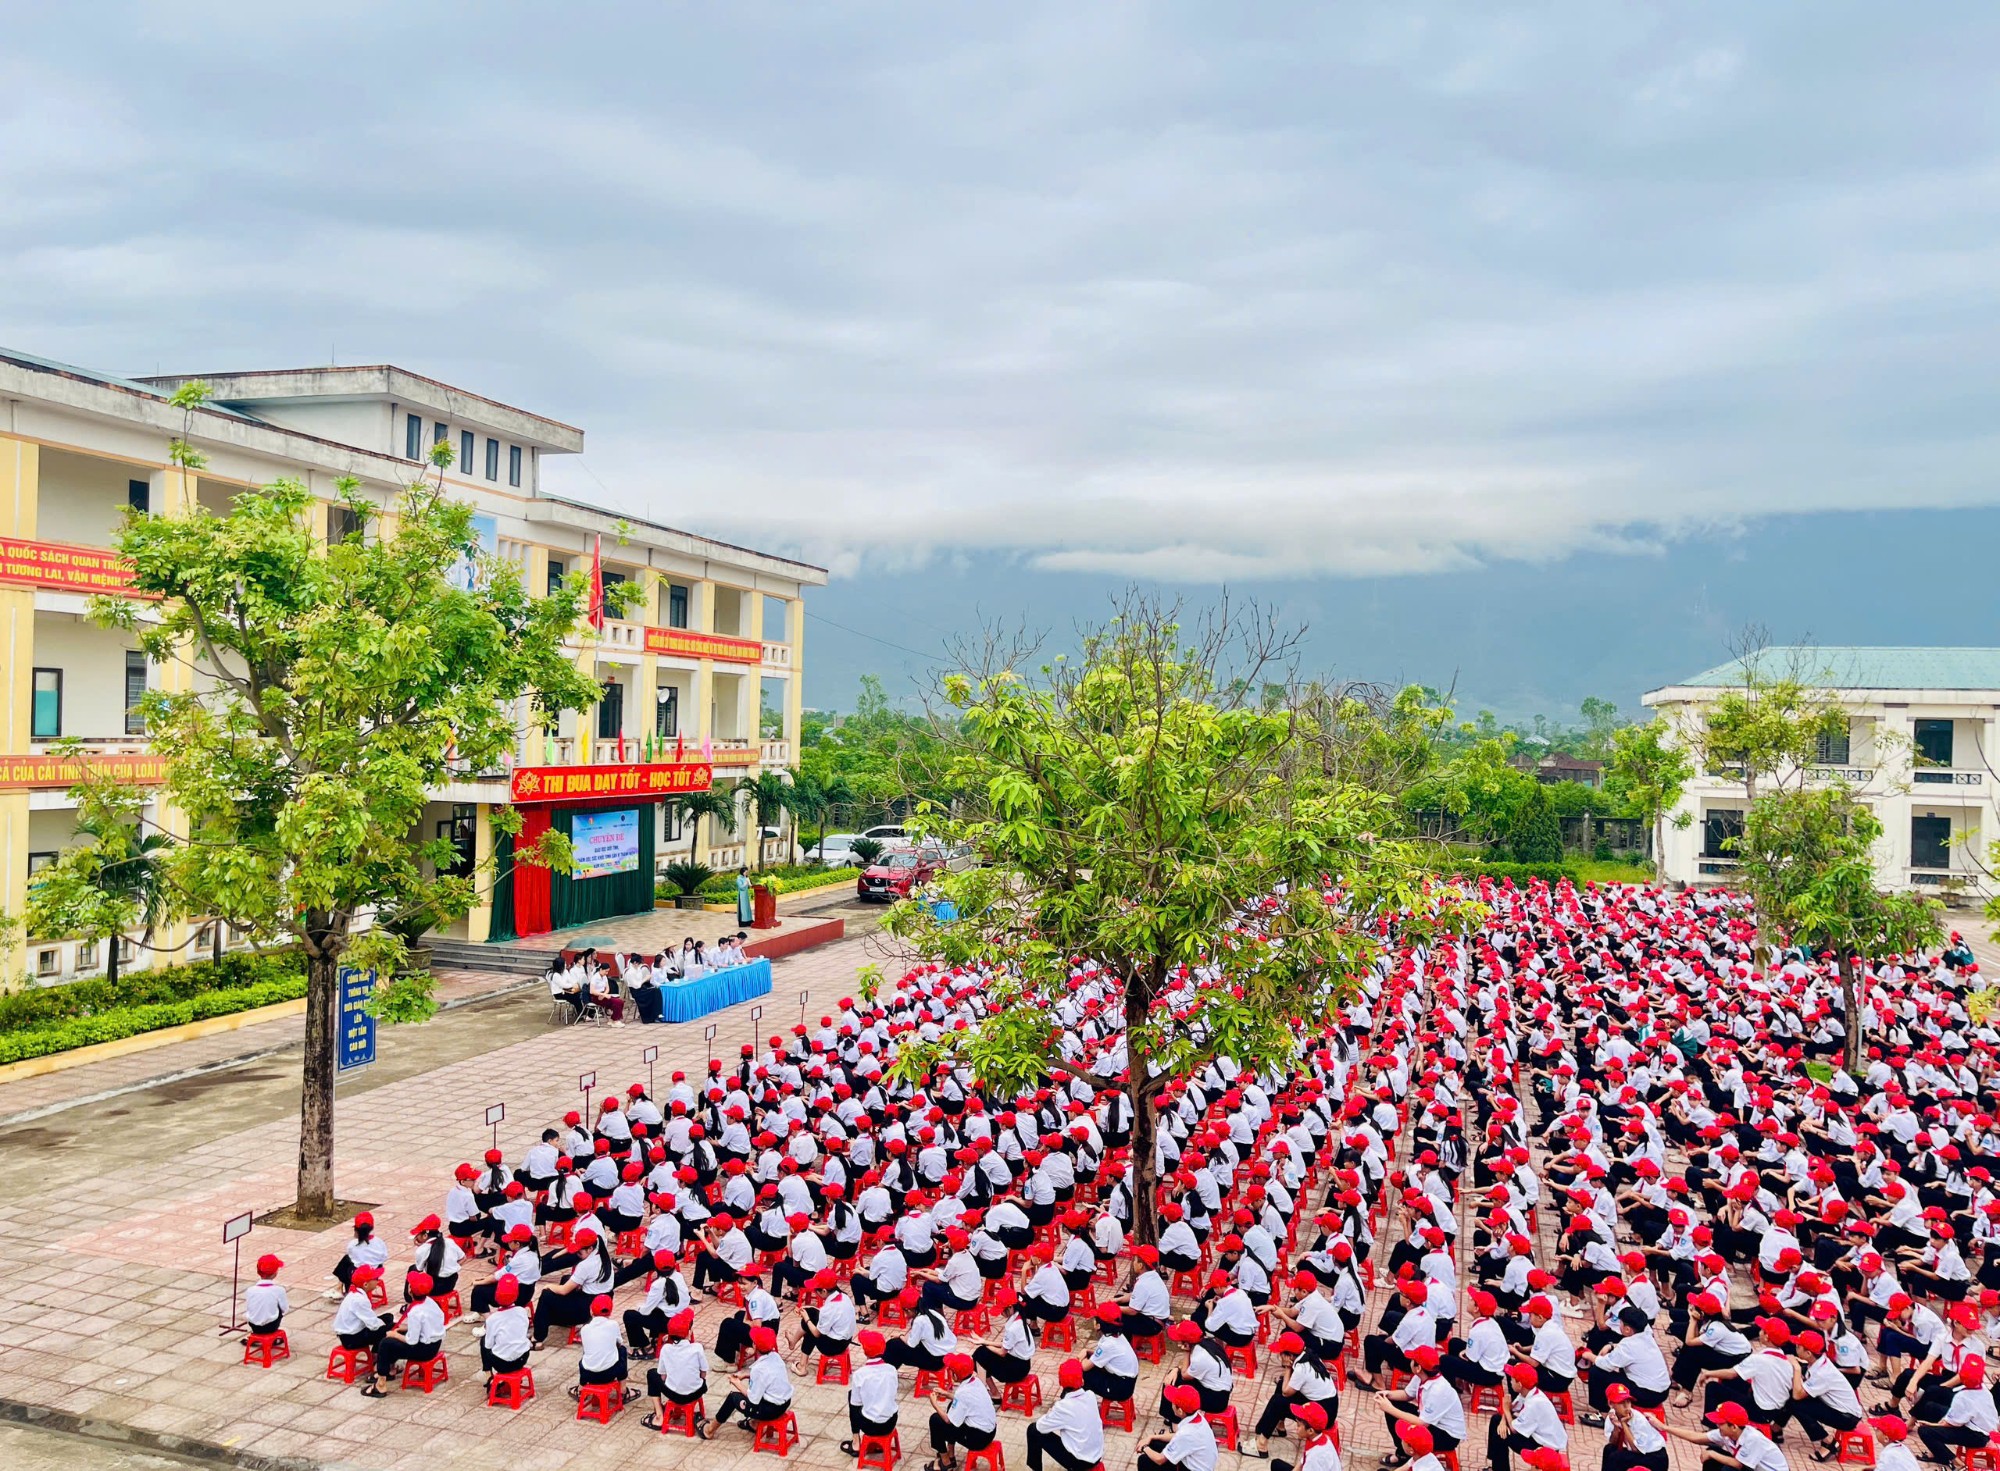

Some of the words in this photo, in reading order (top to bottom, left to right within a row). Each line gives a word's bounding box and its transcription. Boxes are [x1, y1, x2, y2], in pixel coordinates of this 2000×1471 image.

[8, 545, 37, 560] QUỐC
[41, 550, 69, 564] SÁCH
[72, 555, 100, 569] QUAN
[6, 563, 42, 578] TƯƠNG
[45, 568, 64, 581] LAI,
[67, 569, 89, 584] VẬN
[13, 759, 35, 781] CỦA
[543, 775, 565, 794] THI
[567, 774, 592, 793] ĐUA
[594, 772, 618, 794] DẠY
[620, 766, 641, 790] TỐT
[650, 773, 672, 791] HỌC
[673, 765, 692, 787] TỐT
[589, 832, 615, 844] CHUYÊN
